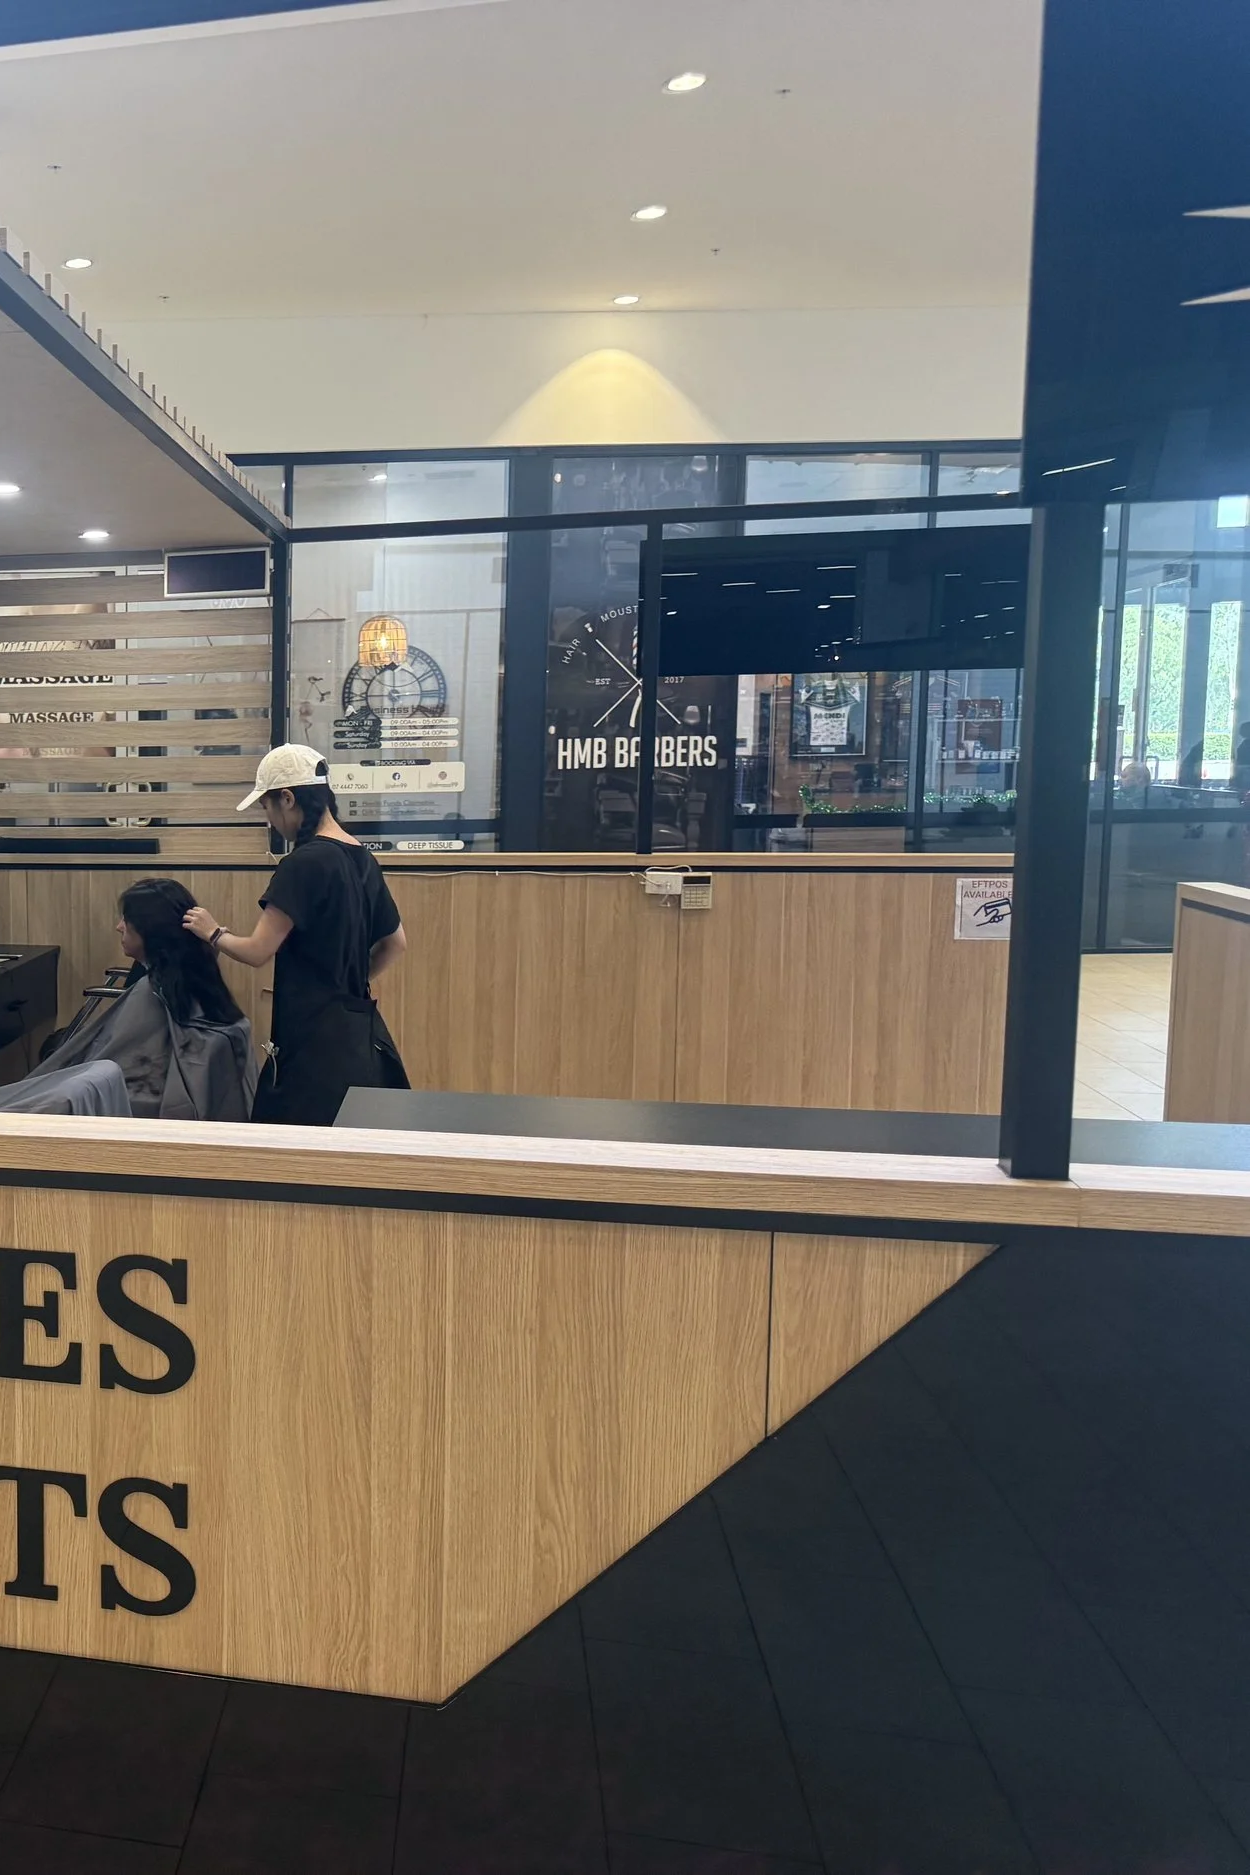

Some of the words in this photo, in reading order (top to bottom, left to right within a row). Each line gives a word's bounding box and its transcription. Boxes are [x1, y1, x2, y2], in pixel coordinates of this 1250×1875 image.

[561, 638, 581, 664] HAIR
[664, 676, 684, 684] 2017
[9, 712, 94, 723] MASSAGE
[557, 737, 607, 769] HMB
[972, 880, 1008, 888] EFTPOS
